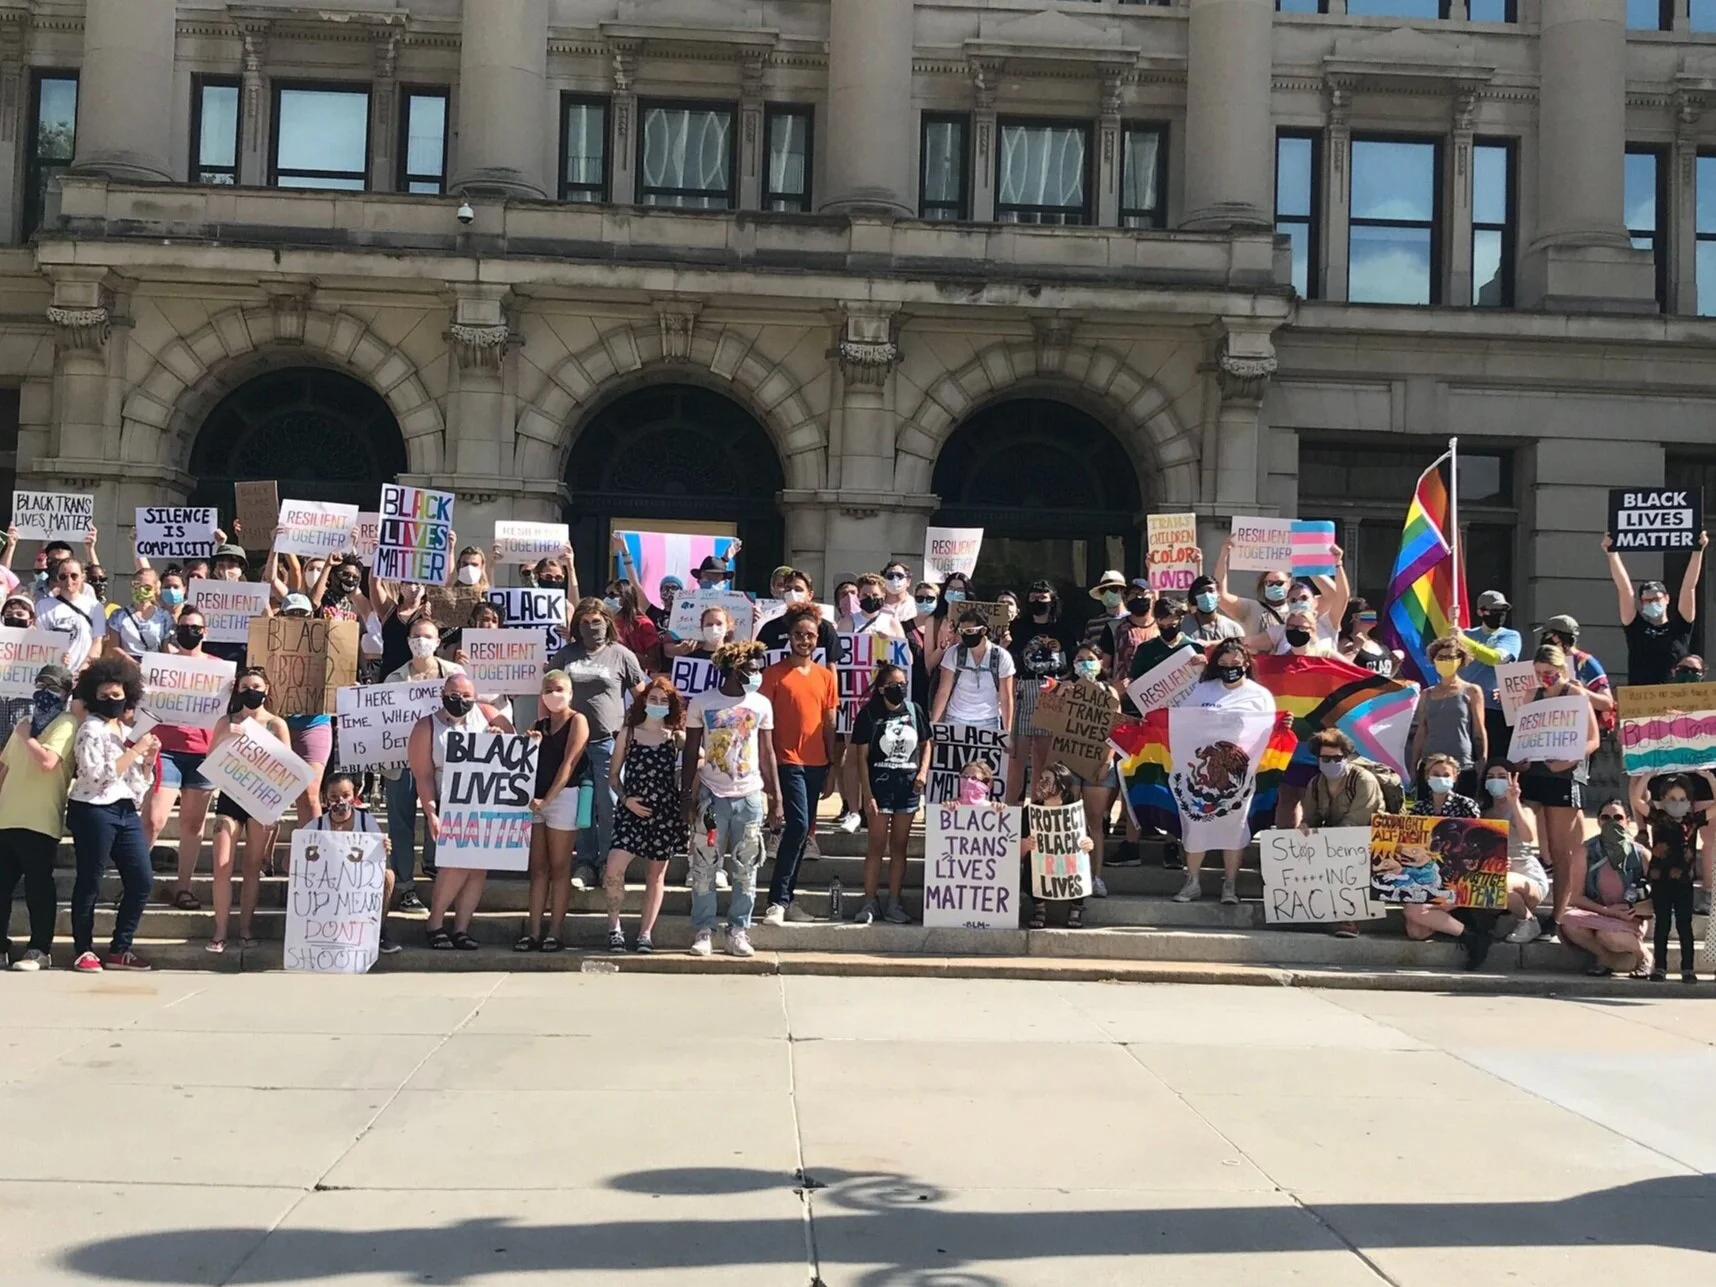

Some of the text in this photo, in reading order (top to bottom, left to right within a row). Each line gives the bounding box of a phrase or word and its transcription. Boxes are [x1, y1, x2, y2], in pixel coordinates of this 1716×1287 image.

[17, 494, 92, 515] BLACK TRANS
[384, 488, 452, 522] BLACK
[1624, 491, 1687, 507] BLACK
[15, 512, 92, 531] LIVES MATTER
[144, 508, 210, 524] SILENCE
[287, 510, 348, 529] RESILIENT
[1626, 512, 1684, 526] LIVES
[163, 525, 185, 538] IS
[285, 527, 346, 549] TOGETHER
[384, 521, 448, 550] LIVES
[1150, 529, 1194, 545] CHILDREN
[1238, 527, 1291, 544] RESILIENT
[1616, 532, 1694, 546] MATTER
[137, 541, 215, 556] COMPLICITY
[504, 538, 560, 553] TOGETHER
[932, 540, 976, 555] RESILIENT
[1151, 547, 1197, 564] COLOR
[1237, 545, 1292, 560] TOGETHER
[377, 548, 445, 581] MATTER
[1151, 570, 1195, 590] LOVED
[196, 592, 261, 611] RESILIENT
[490, 591, 562, 621] BLACK
[267, 618, 340, 654] BLACK
[0, 641, 60, 663] ESILIENT
[470, 643, 537, 660] RESILIENT
[149, 668, 225, 692] RESILIENT
[471, 664, 537, 681] TOGETHER
[1139, 659, 1199, 708] RESILIENT
[148, 691, 221, 714] TOGETHER
[350, 686, 396, 709] THERE
[1072, 684, 1112, 709] BLACK
[338, 713, 372, 729] TIME
[382, 709, 422, 724] WHEN
[1067, 700, 1111, 726] TRANS
[1519, 710, 1579, 733] RESILIENT
[933, 725, 1009, 748] BLACK
[1065, 719, 1109, 742] LIVES
[1517, 731, 1578, 750] TOGETHER
[353, 741, 367, 755] IS
[446, 732, 538, 773] BLACK
[1052, 736, 1104, 760] MATTER
[232, 733, 300, 791] RESILIENT
[341, 761, 386, 774] #BLACK
[933, 745, 1000, 775] LIVES
[218, 751, 282, 810] TOGETHER
[448, 772, 531, 807] LIVES
[438, 811, 534, 848] MATTER
[940, 810, 1011, 833] BLACK
[1030, 805, 1084, 832] PROTECT
[1372, 814, 1428, 831] GOODNIGHT
[945, 836, 1008, 857] TRANS
[1037, 832, 1081, 855] BLACK
[1371, 830, 1429, 844] ALT-RIGHT
[1272, 836, 1368, 865] Stop being
[291, 860, 386, 891] HANDS
[936, 858, 996, 880] LIVES
[1040, 875, 1083, 898] LIVES
[294, 891, 330, 917] UP
[926, 885, 1010, 913] MATTER
